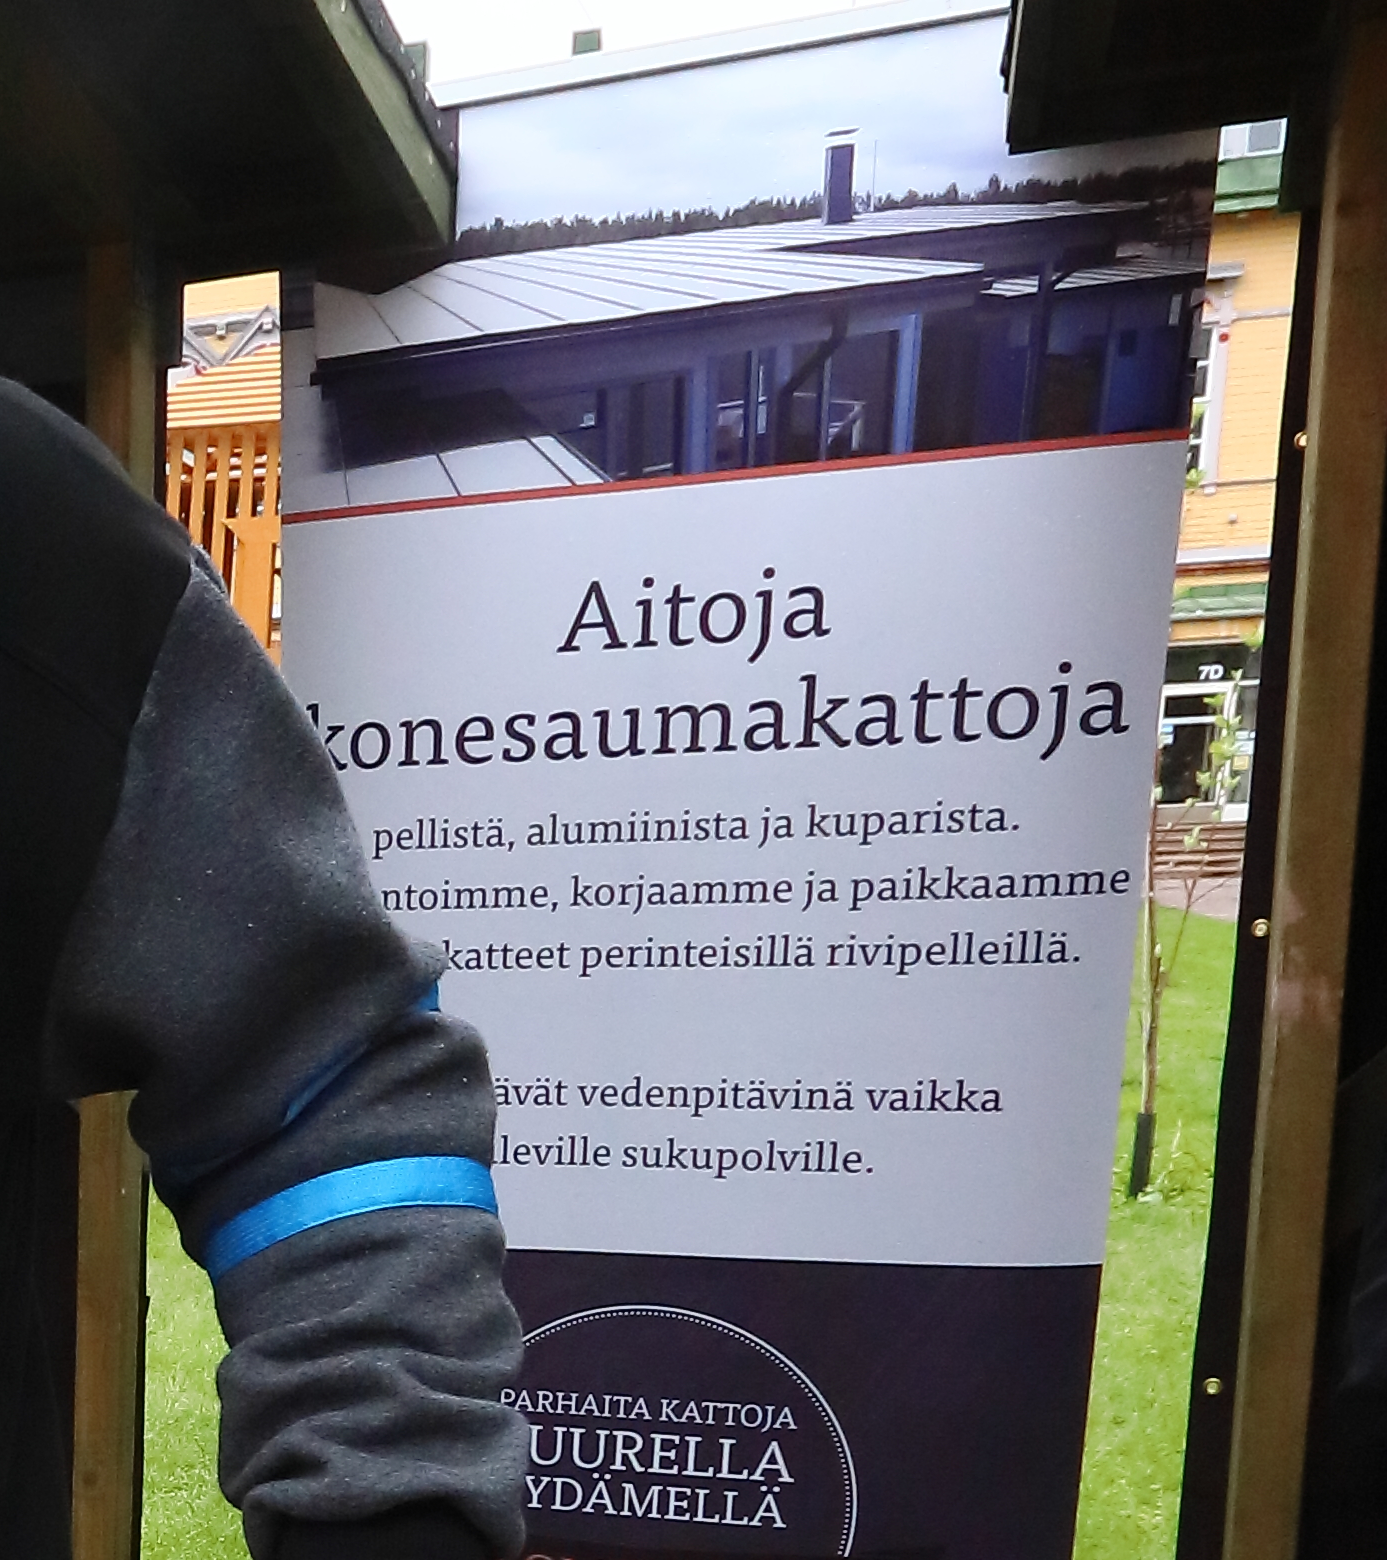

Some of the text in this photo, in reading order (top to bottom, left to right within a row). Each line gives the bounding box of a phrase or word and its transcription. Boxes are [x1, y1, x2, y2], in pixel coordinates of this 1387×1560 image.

[556, 567, 832, 664] Aitoja
[1198, 664, 1224, 680] 7D
[373, 800, 1020, 859] pellistä, alumiinista ja kuparista.
[382, 866, 1131, 914] ntoimme, korjaamme ja paikkaamme
[443, 931, 1080, 977] katteet perinteisillä rivipelleillä.
[578, 1076, 854, 1118] vedenpitävinä
[867, 1078, 1002, 1112] vaikka
[492, 1134, 875, 1179] leville sukupolville.
[500, 1388, 797, 1432] PARHAITA KATTOJA
[527, 1424, 795, 1483] UURELLA
[525, 1472, 787, 1528] YDÄMELLÄ
